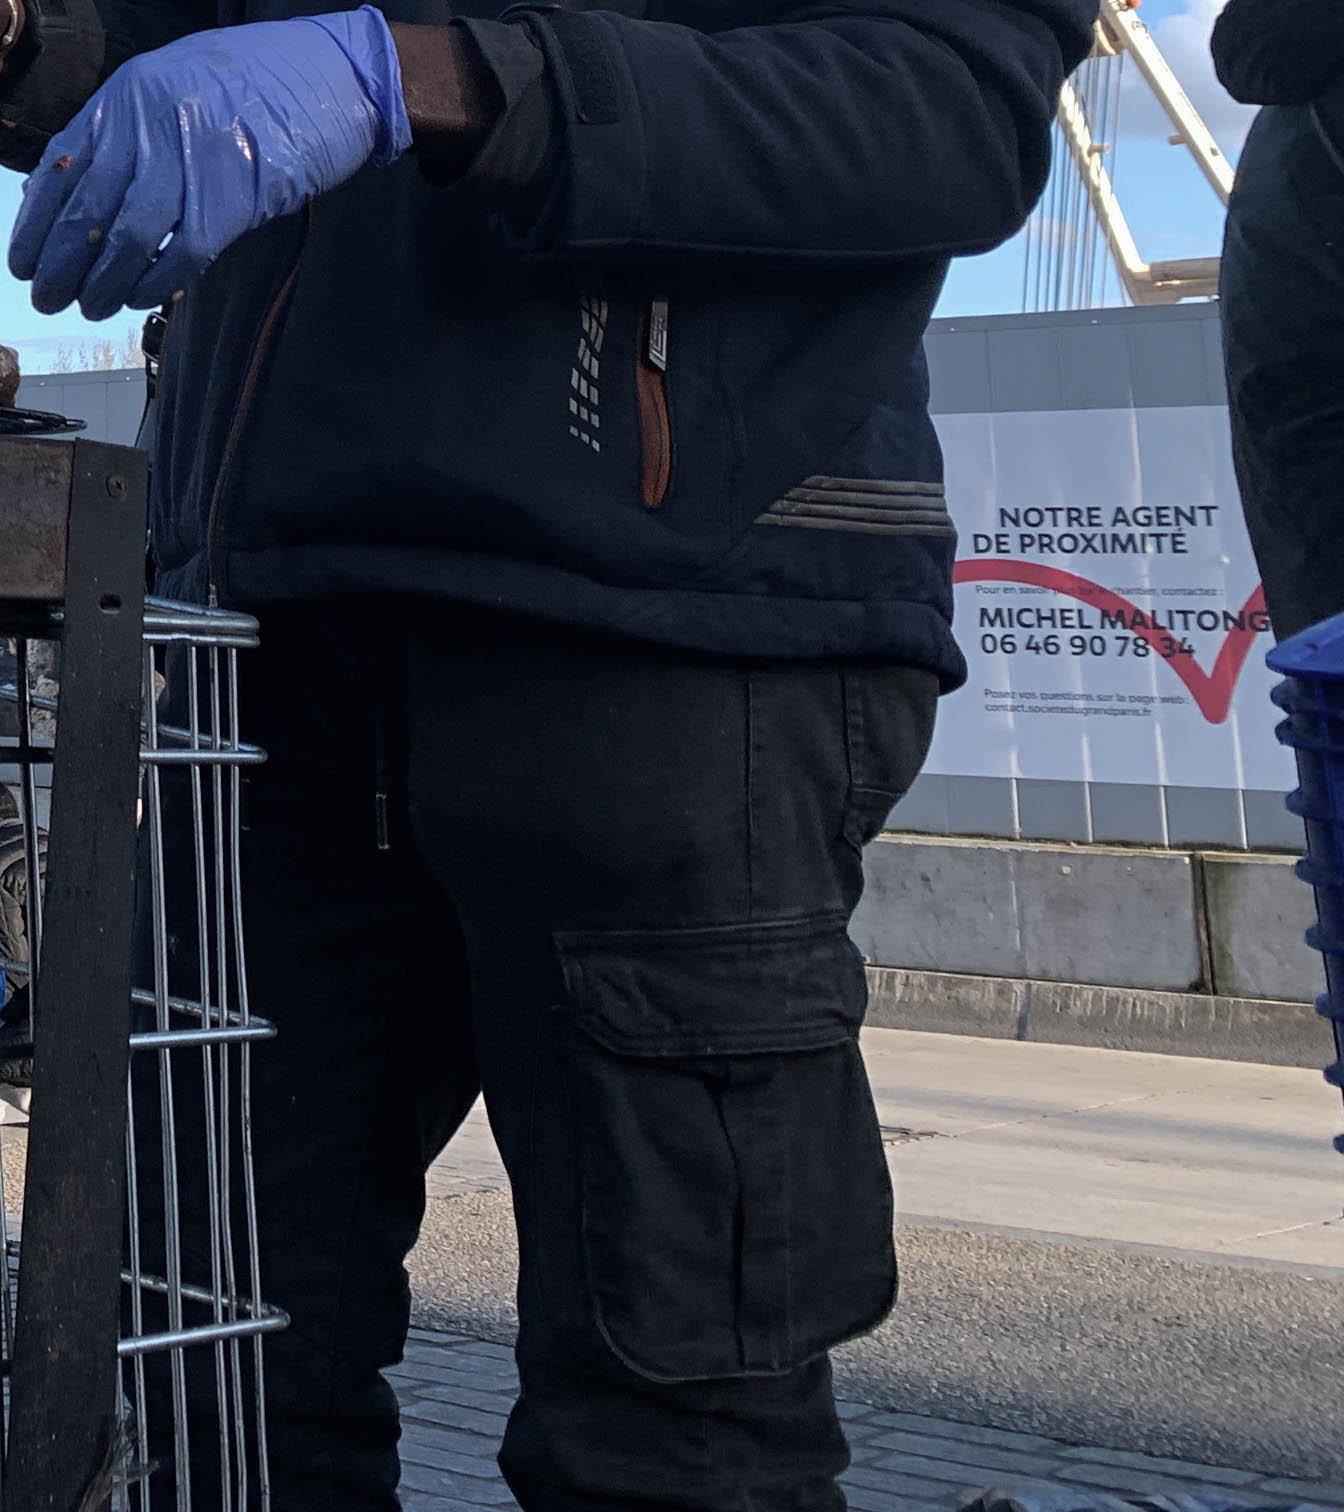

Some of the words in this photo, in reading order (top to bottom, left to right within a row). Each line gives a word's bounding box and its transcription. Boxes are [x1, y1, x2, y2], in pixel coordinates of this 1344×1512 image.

[999, 507, 1102, 528] NOTRE
[1111, 505, 1219, 527] AGENT
[972, 533, 1011, 554] DE
[1020, 527, 1189, 554] PROXIMITÉ
[979, 607, 1092, 630] MICHEL
[1101, 608, 1272, 633] MALITONG
[981, 634, 1017, 655] 06
[1024, 634, 1060, 656] 46
[1070, 635, 1107, 657] 90
[1114, 635, 1150, 658] 78
[1159, 637, 1196, 659] 34
